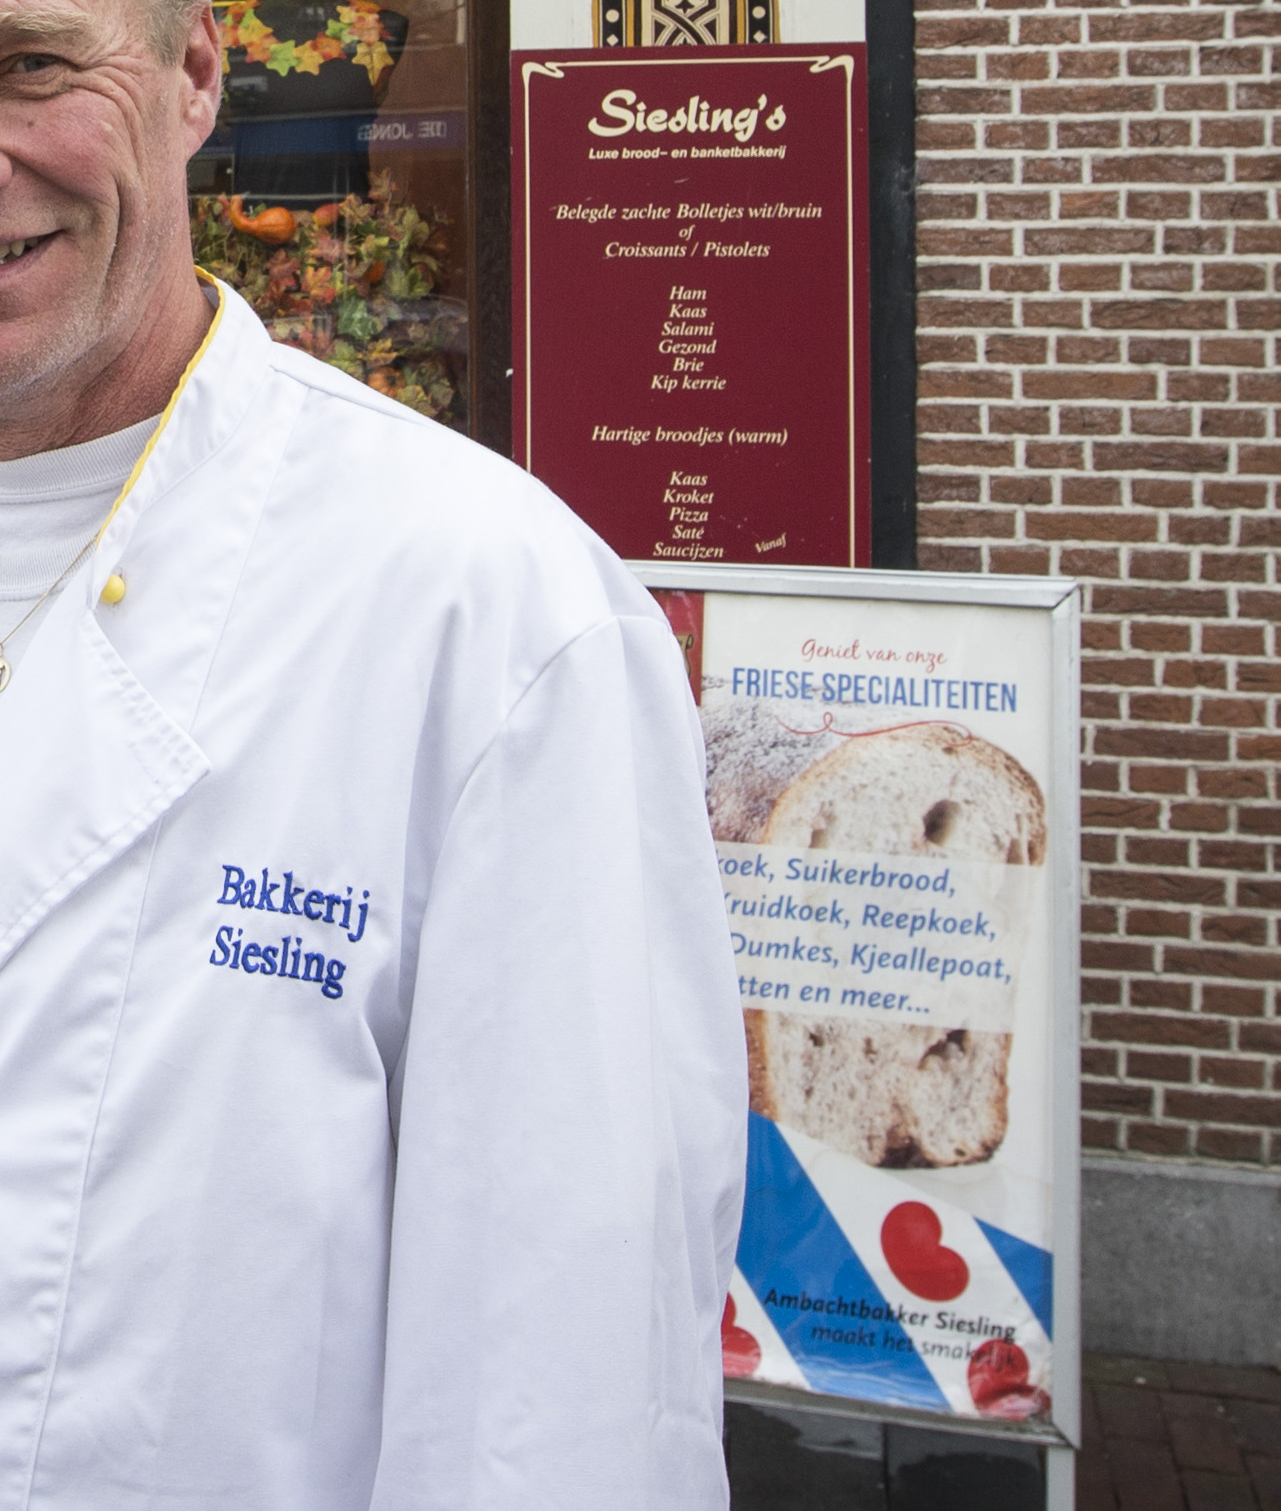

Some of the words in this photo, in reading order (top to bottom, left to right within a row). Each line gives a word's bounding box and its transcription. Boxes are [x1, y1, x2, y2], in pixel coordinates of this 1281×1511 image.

[588, 89, 787, 143] Siesling's
[589, 148, 619, 159] Luxe
[671, 149, 688, 158] en
[691, 145, 787, 159] banketbakkerij
[556, 204, 617, 223] Belegde
[621, 204, 671, 220] zachte
[676, 203, 744, 222] Bolletjes
[748, 203, 823, 219] wit/bruin
[679, 225, 695, 241] of
[605, 242, 687, 258] Croissants
[690, 242, 699, 258] /
[704, 242, 771, 258] Pistolets
[669, 286, 707, 300] Ham
[669, 304, 708, 318] Kaas
[661, 322, 714, 336] Salami
[658, 340, 717, 354] Gezond
[672, 358, 704, 372] Brie
[651, 375, 678, 393] Kip
[682, 376, 727, 390] kerrie
[591, 426, 651, 445] Hartige
[655, 427, 723, 446] broodjes
[728, 428, 788, 446] (warm)
[669, 471, 708, 486] Kaas
[663, 489, 714, 504] Kroket
[669, 507, 709, 522] Pizza
[672, 525, 705, 539] Saté
[653, 542, 724, 560] Saucijzen
[754, 532, 787, 554] Vanaf
[801, 639, 861, 662] Geniet
[866, 649, 902, 661] van
[905, 650, 948, 673] onze
[732, 667, 814, 700] FRIESE
[821, 672, 1018, 713] SPECIALITEITEN
[785, 858, 956, 898] Suikerbrood,
[217, 864, 370, 942] Bakkerij
[861, 900, 996, 943] Reepkoek,
[209, 925, 347, 999] Siesling
[850, 942, 1012, 986] Kjeallepoat,
[799, 985, 831, 1003] en
[840, 989, 930, 1014] meer...
[764, 1287, 930, 1330] Ambachtbakker
[935, 1311, 1017, 1345] Siesling
[811, 1325, 876, 1349] maakt
[882, 1334, 913, 1354] het
